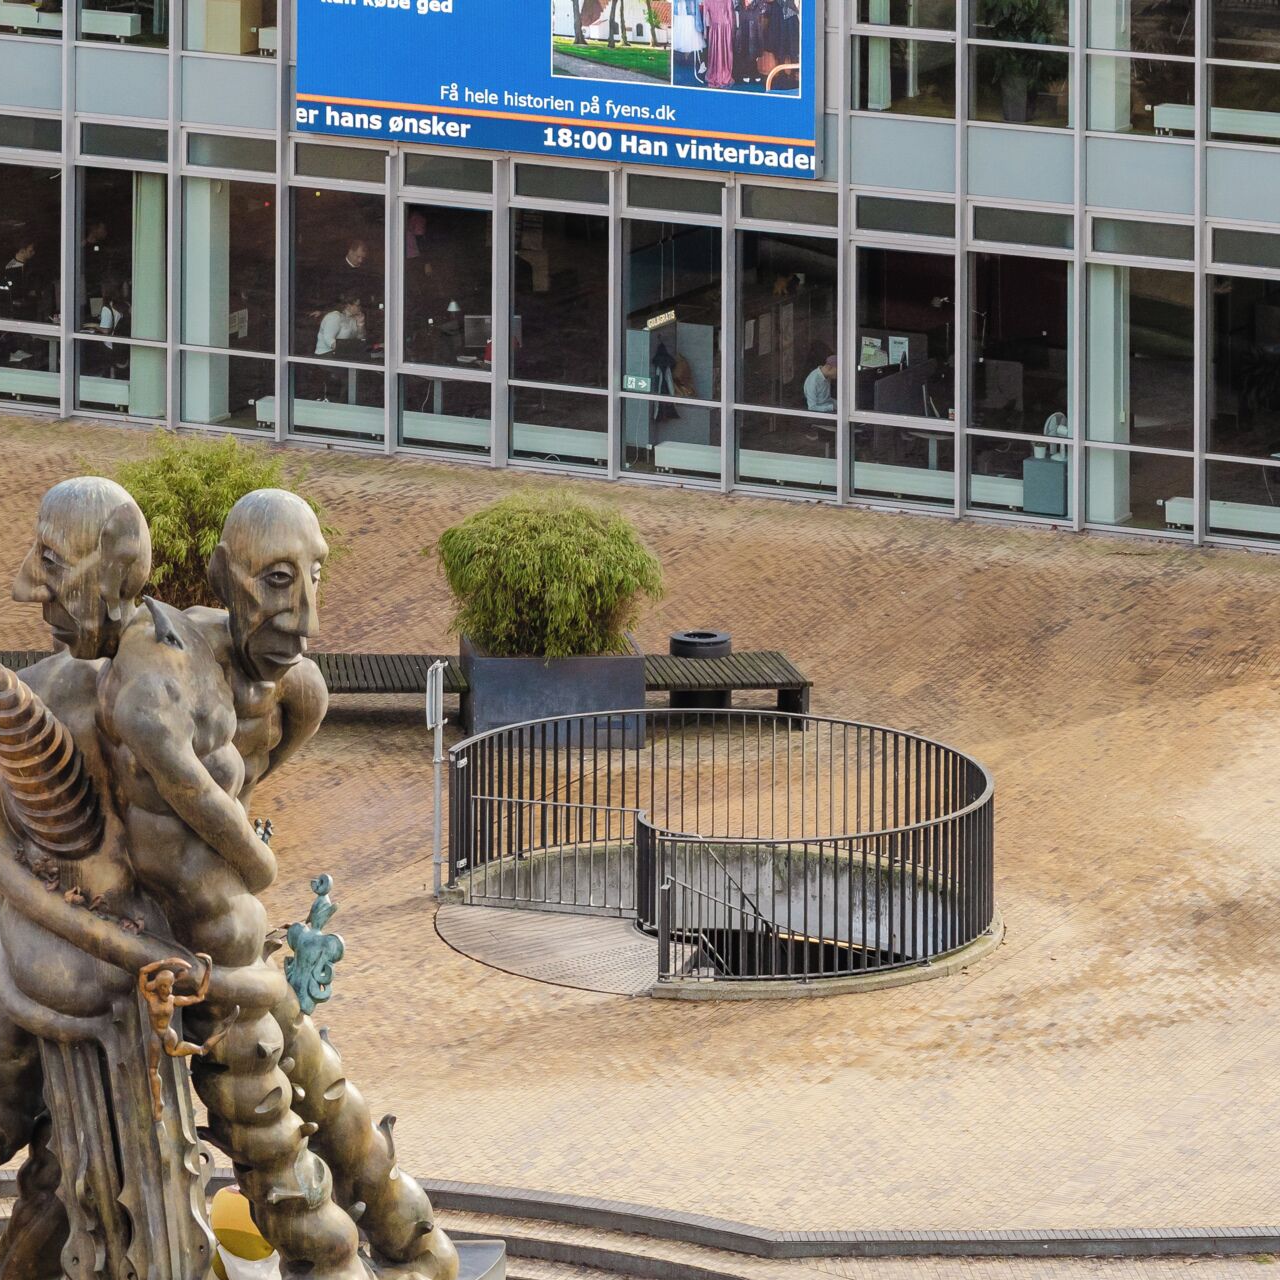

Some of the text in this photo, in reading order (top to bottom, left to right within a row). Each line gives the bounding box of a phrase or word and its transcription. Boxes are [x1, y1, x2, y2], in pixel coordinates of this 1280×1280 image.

[417, 0, 453, 14] ged
[440, 83, 676, 121] Få hele historien på fyens.dk
[326, 106, 382, 130] hans
[389, 115, 471, 138] ønsker
[543, 128, 613, 151] 18:00
[620, 134, 668, 157] Han
